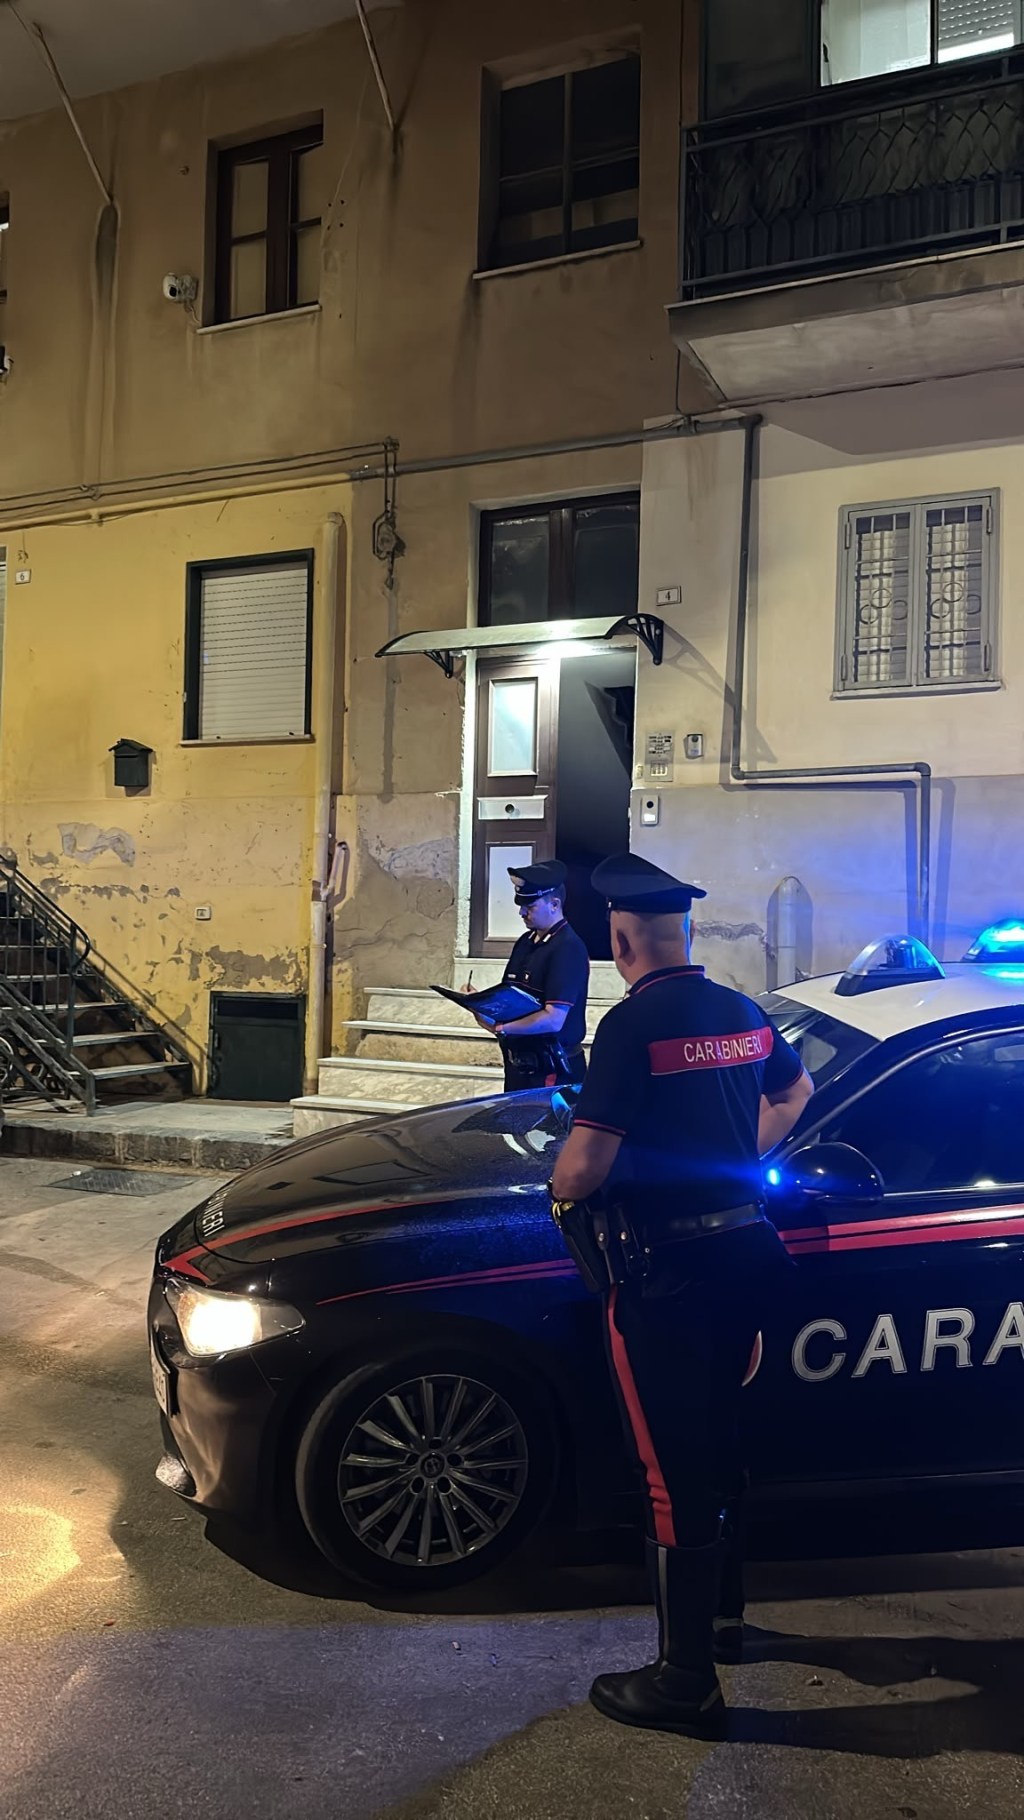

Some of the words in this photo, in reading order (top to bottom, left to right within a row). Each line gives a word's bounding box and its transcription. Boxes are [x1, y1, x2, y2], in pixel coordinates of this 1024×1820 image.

[20, 572, 25, 581] 6
[664, 591, 671, 601] 4
[683, 1034, 763, 1063] CARABINIERI
[791, 1301, 1024, 1383] CARA
